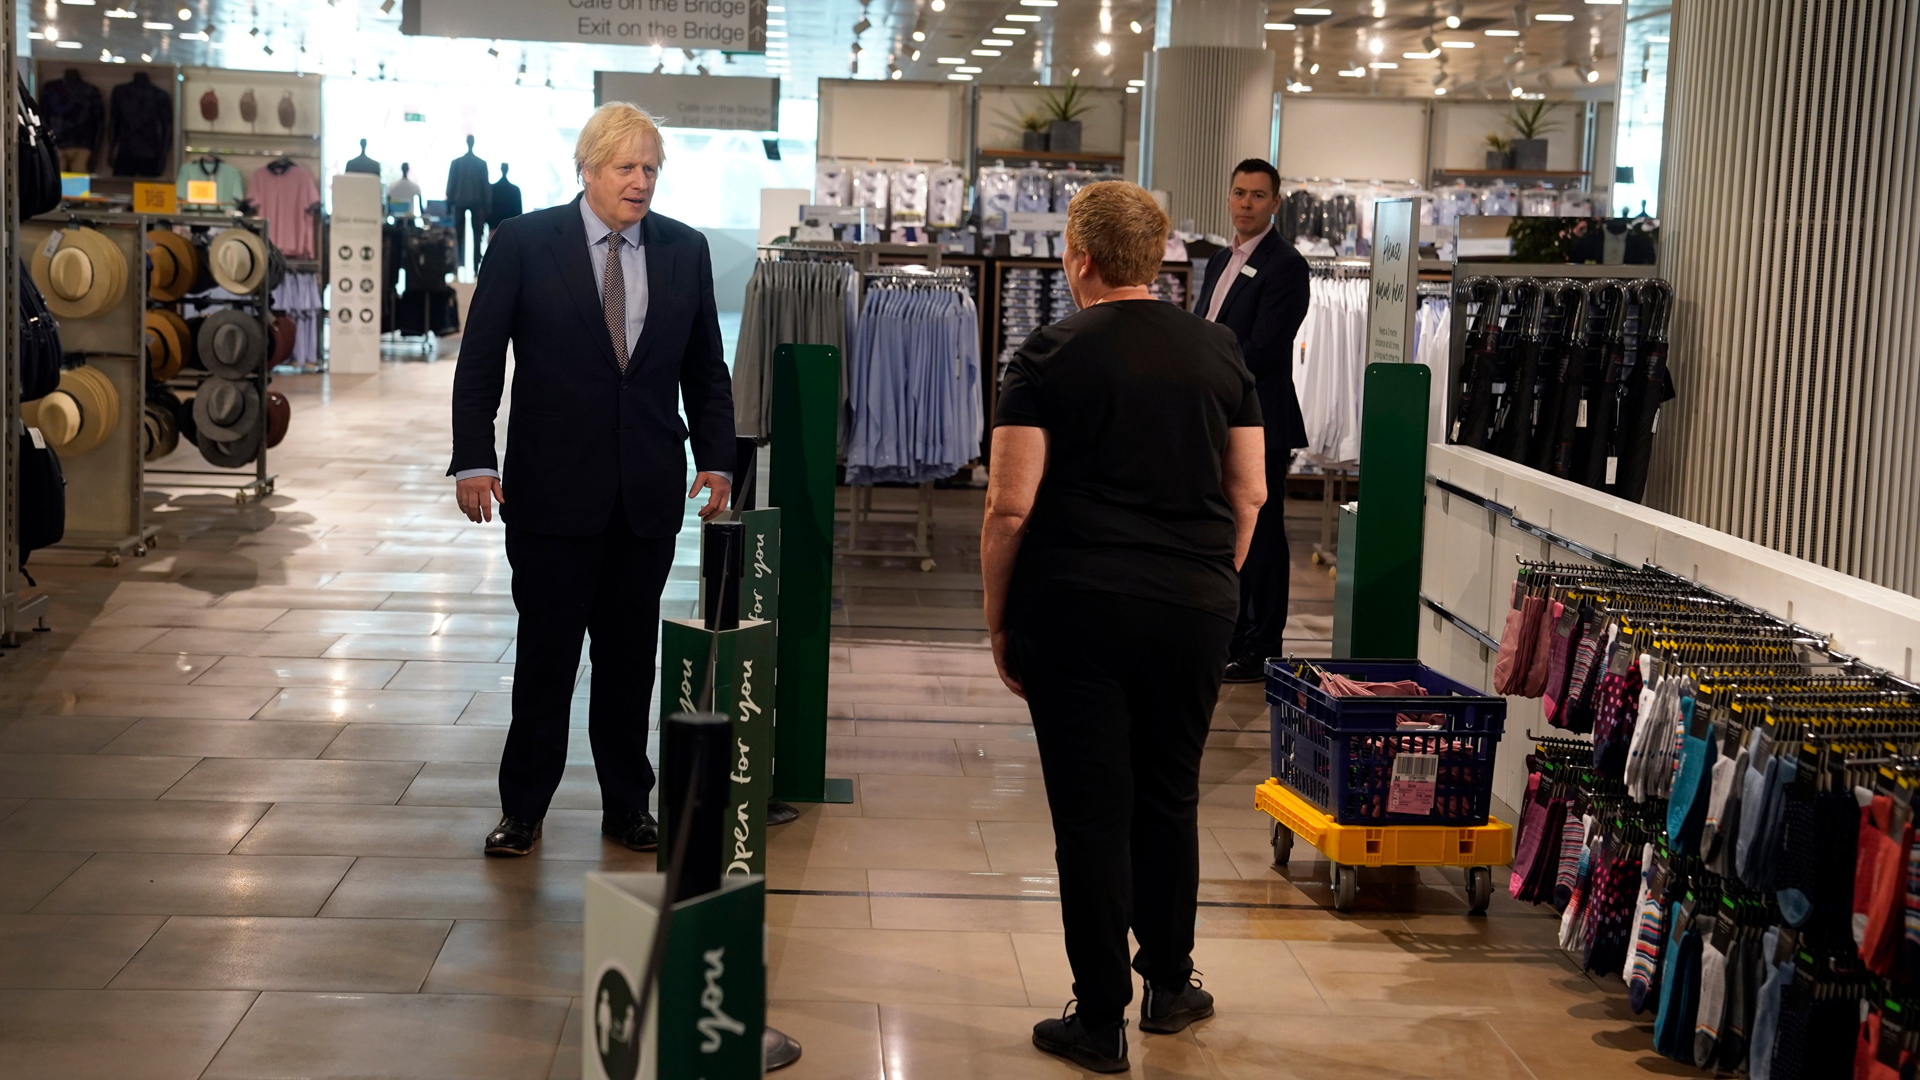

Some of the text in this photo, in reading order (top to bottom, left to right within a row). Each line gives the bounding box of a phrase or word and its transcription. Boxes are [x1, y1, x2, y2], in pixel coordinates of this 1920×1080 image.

[618, 0, 642, 10] on
[649, 0, 678, 12] the
[684, 0, 746, 19] Bridge
[578, 17, 745, 45] Exit on the Bridge
[1383, 235, 1402, 265] Please
[1375, 273, 1405, 311] queue here
[748, 533, 772, 621] for you
[739, 659, 762, 723] you
[730, 737, 751, 784] for
[696, 946, 746, 1053] you
